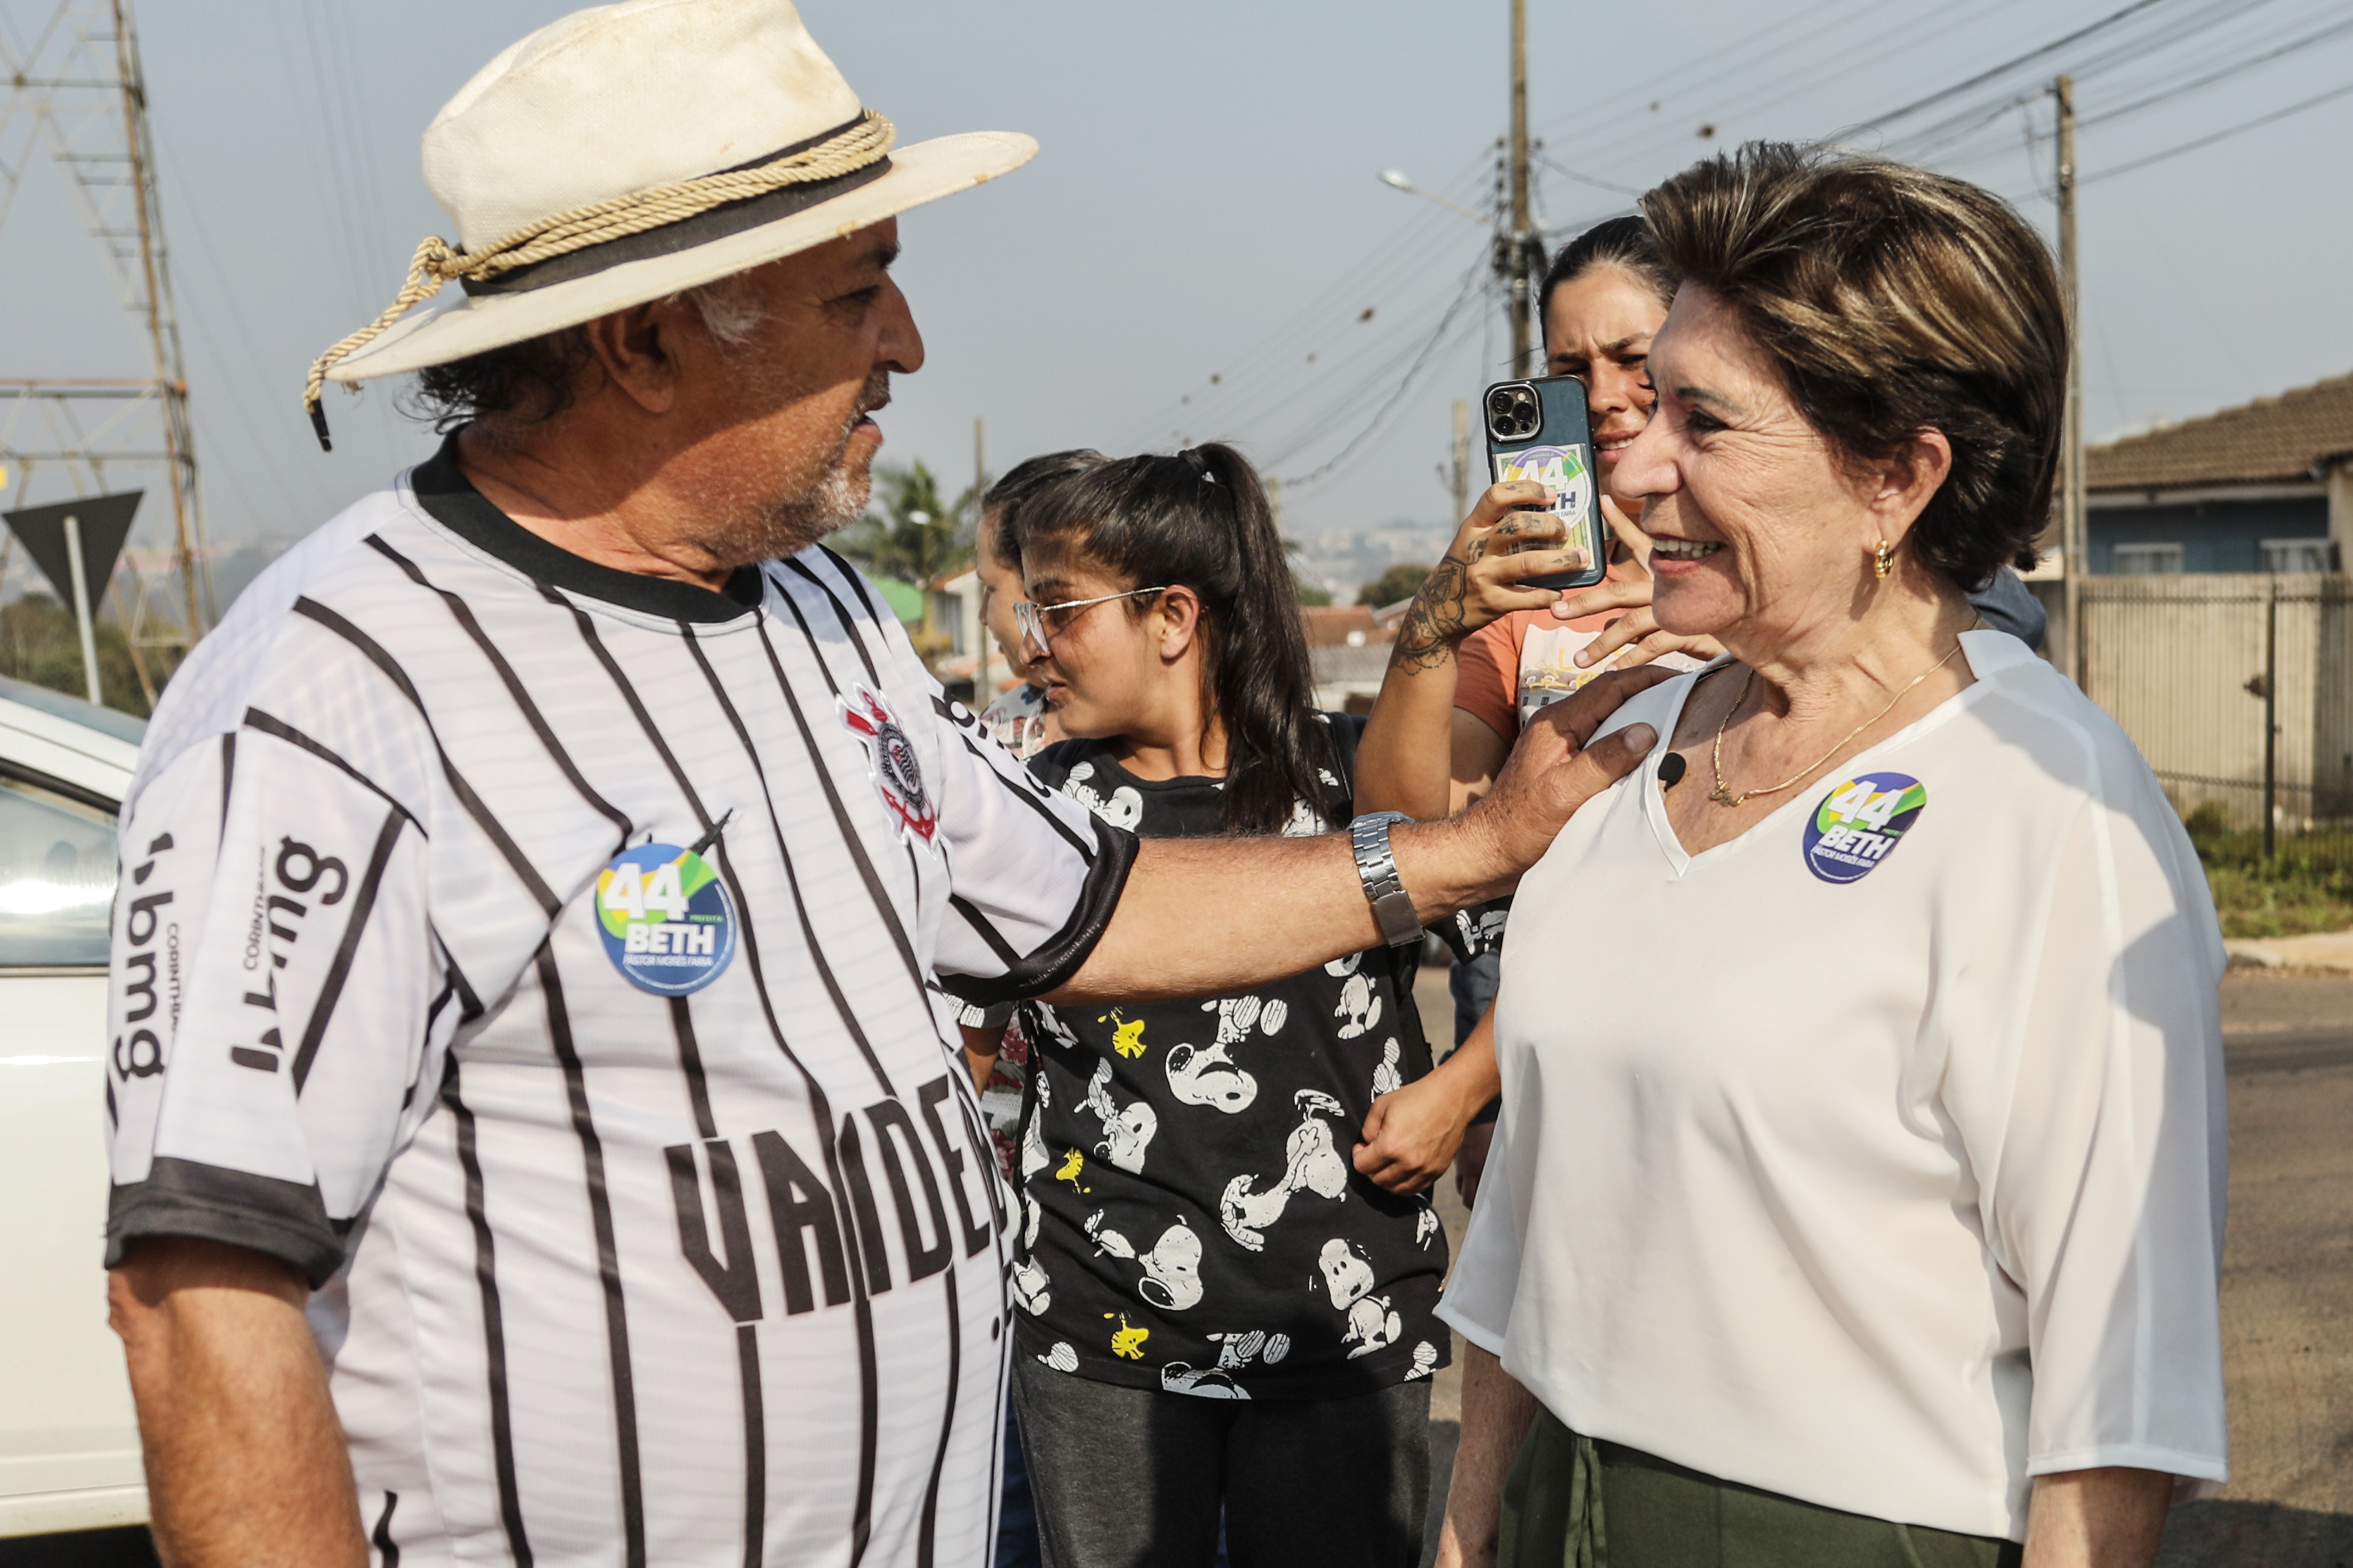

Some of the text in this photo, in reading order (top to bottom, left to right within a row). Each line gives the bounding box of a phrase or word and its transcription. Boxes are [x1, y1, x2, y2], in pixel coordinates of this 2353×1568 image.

[1827, 780, 1905, 832] 44
[1818, 824, 1895, 860] BETH
[602, 862, 690, 921] 44
[623, 955, 656, 966] PASTOR
[687, 956, 714, 967] FARIA
[624, 923, 716, 955] BETH
[115, 891, 174, 1082] bmg
